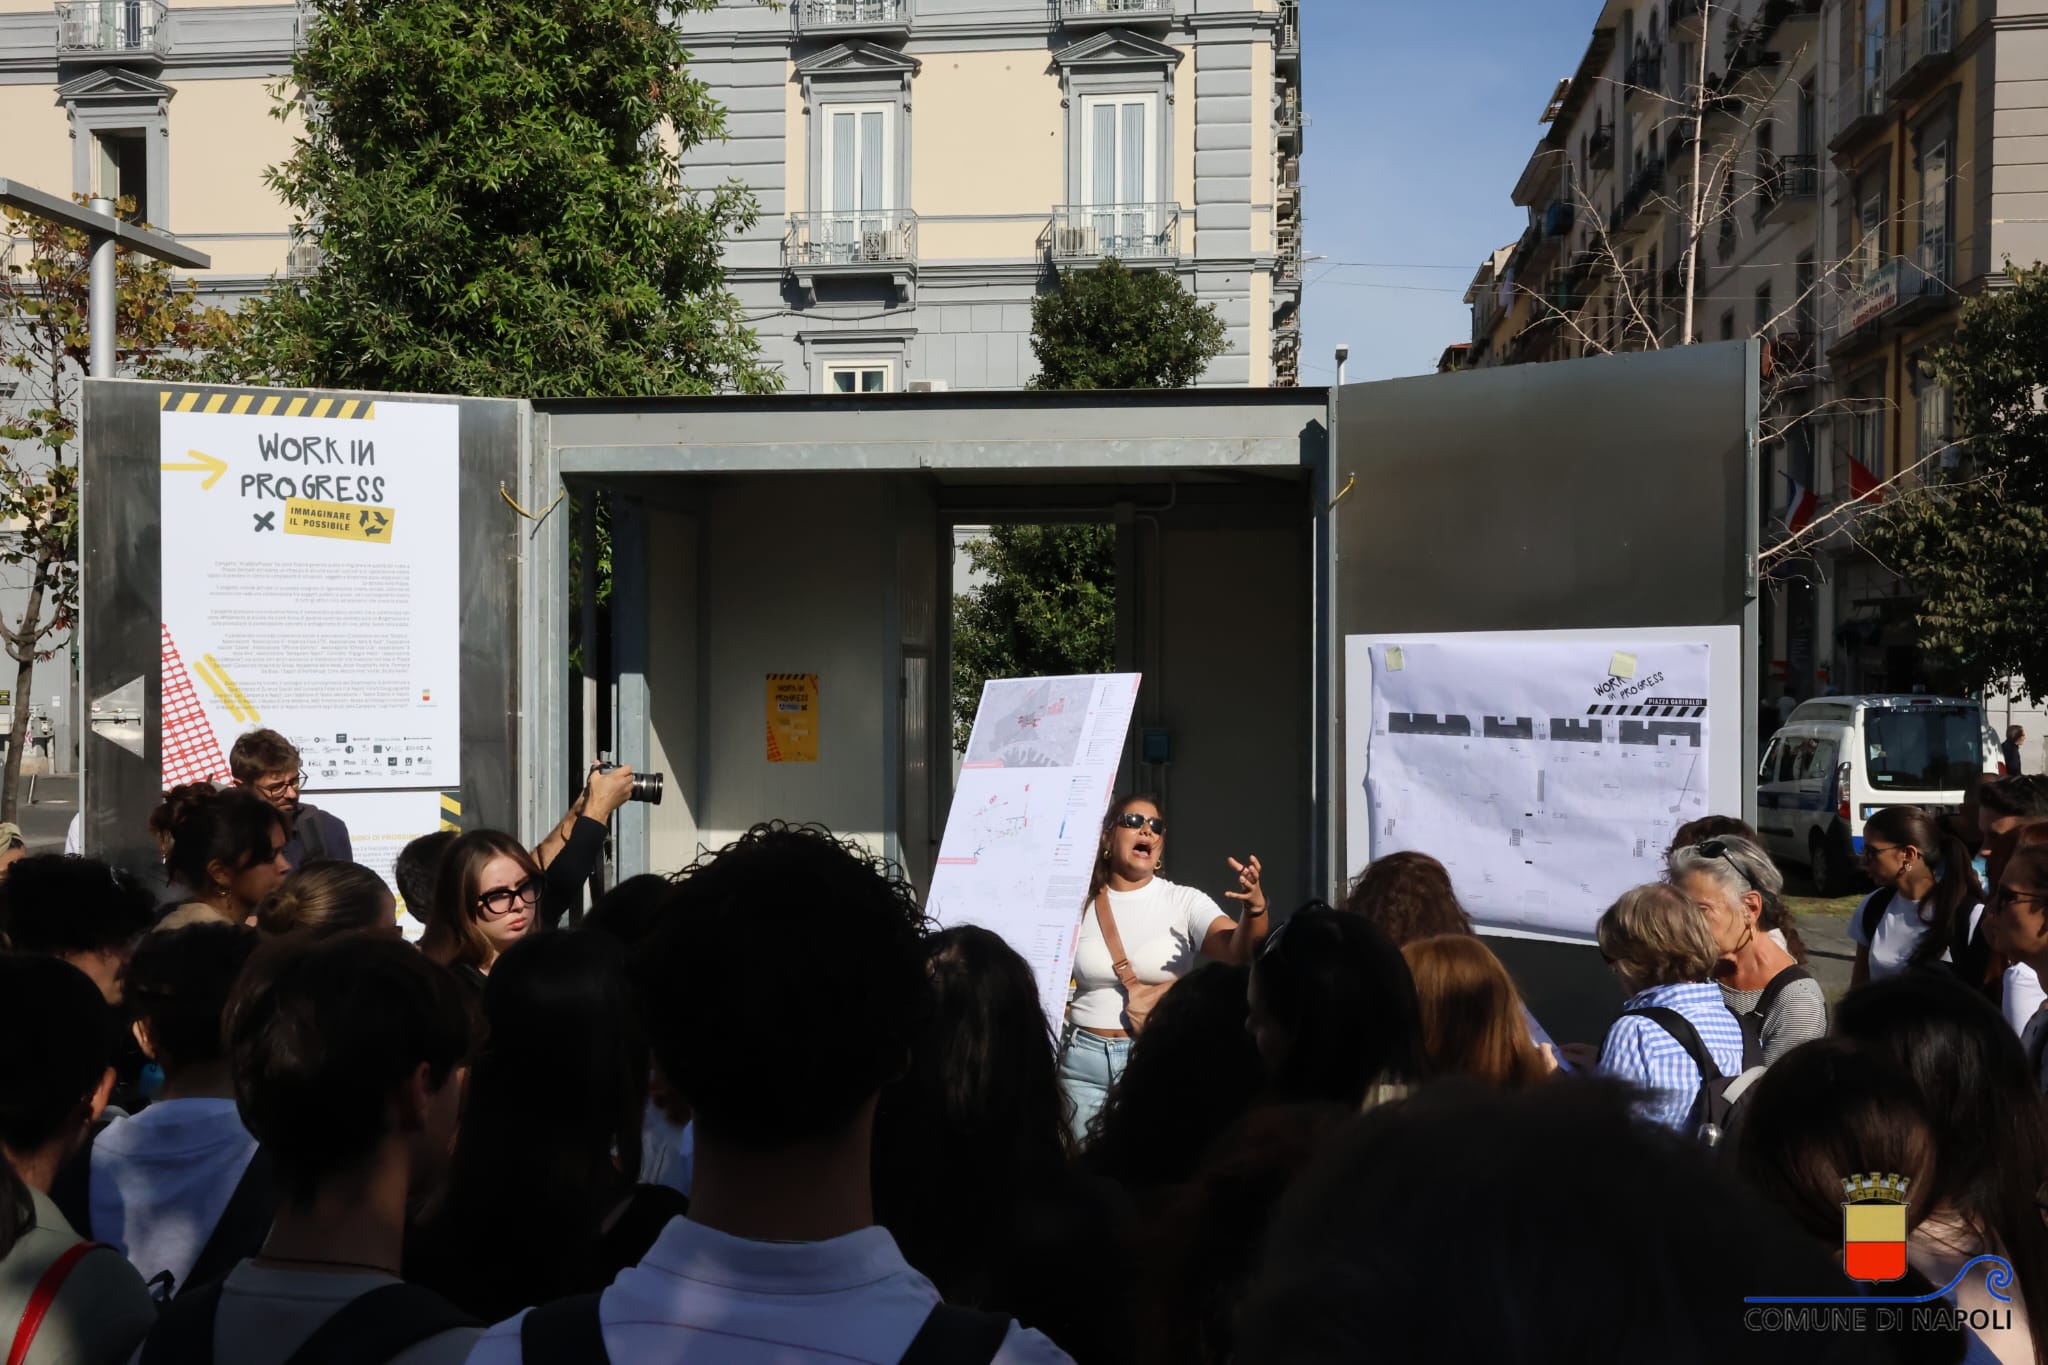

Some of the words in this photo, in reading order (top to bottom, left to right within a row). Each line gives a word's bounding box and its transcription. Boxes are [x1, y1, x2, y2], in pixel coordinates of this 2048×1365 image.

[258, 432, 344, 466] WORK
[350, 439, 375, 466] IN
[240, 473, 385, 503] PROGRESS
[289, 517, 299, 526] IL
[303, 519, 351, 531] POSSIBILE
[290, 506, 351, 521] IMMAGINARE
[1593, 676, 1626, 697] WORK
[1619, 671, 1664, 700] PROGRESS
